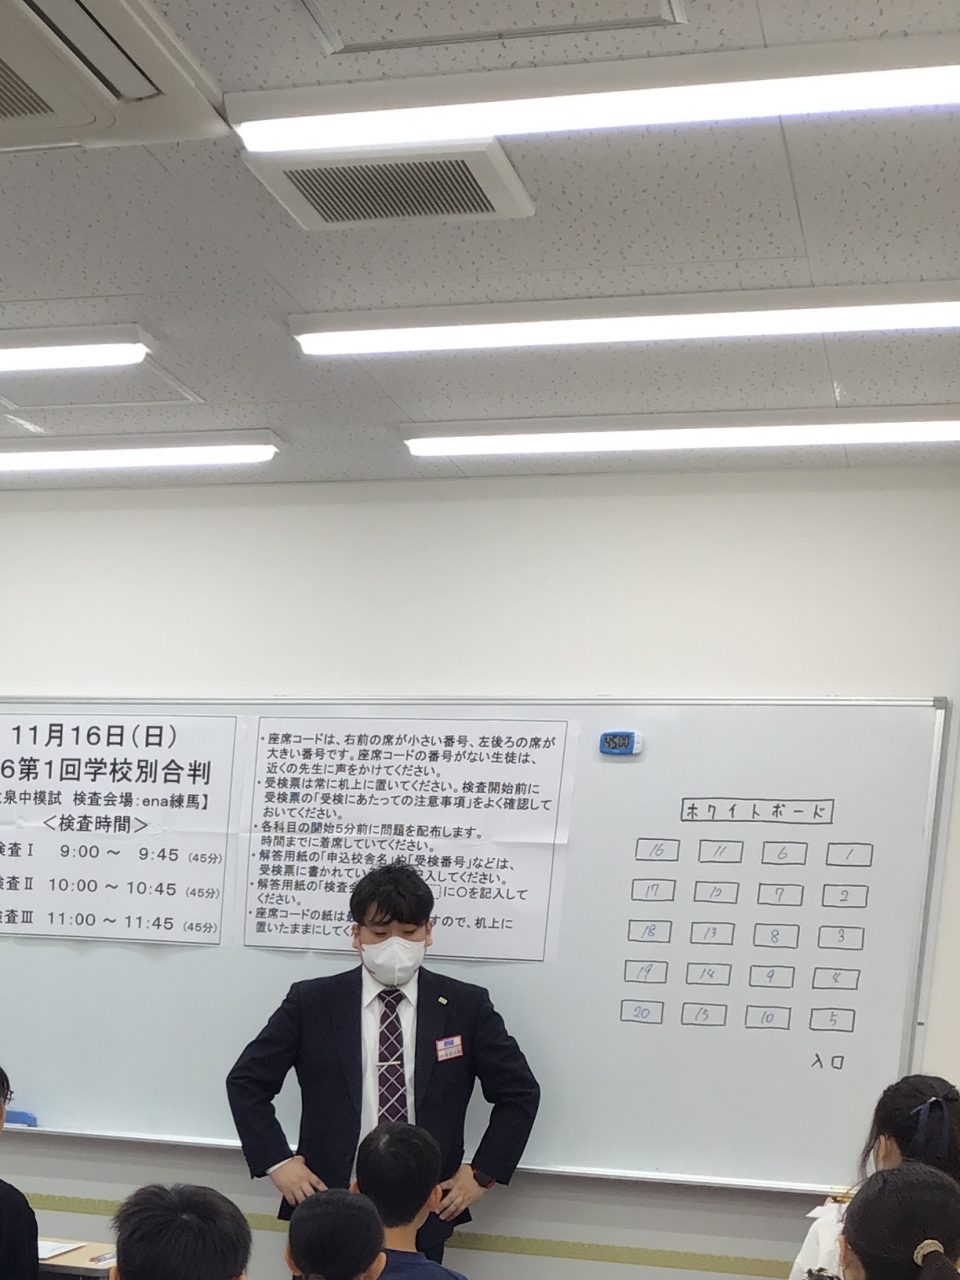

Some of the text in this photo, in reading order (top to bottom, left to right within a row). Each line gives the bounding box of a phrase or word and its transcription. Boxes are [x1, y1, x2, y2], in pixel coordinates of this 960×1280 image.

[11, 723, 178, 749] 11月16日(日)
[267, 747, 537, 765] 大きい番号です。座席コードの番号がない生徒は、
[266, 762, 441, 778] 近くの先生に声をかけてください。
[264, 791, 553, 811] 受検票の「受検にあたっての注意事項」をよく確認して
[263, 806, 343, 821] おいてください。
[687, 803, 826, 820] ホワイトボード
[260, 835, 434, 853] 時間までに着席していてください。
[649, 843, 665, 857] 16
[713, 846, 727, 857] 11
[777, 846, 788, 860] 6
[60, 845, 100, 858] 9:00
[139, 847, 179, 862] 9:45
[187, 852, 223, 865] (45分)
[259, 864, 374, 879] 受検票に書かれてい
[49, 878, 98, 892] 10:00
[127, 881, 177, 896] 10:45
[185, 886, 221, 900] (45分)
[840, 889, 849, 902] 2
[257, 892, 302, 906] ください。
[47, 911, 96, 926] 11:00
[124, 915, 174, 931] 11:45
[183, 921, 218, 934] (45分)
[255, 921, 354, 937] 置いたままにしてく
[641, 923, 845, 944] 18 13 8 3
[637, 963, 653, 981] 19
[700, 968, 715, 980] 14
[766, 969, 775, 983] 9
[633, 1006, 838, 1026] 20 15 10 5
